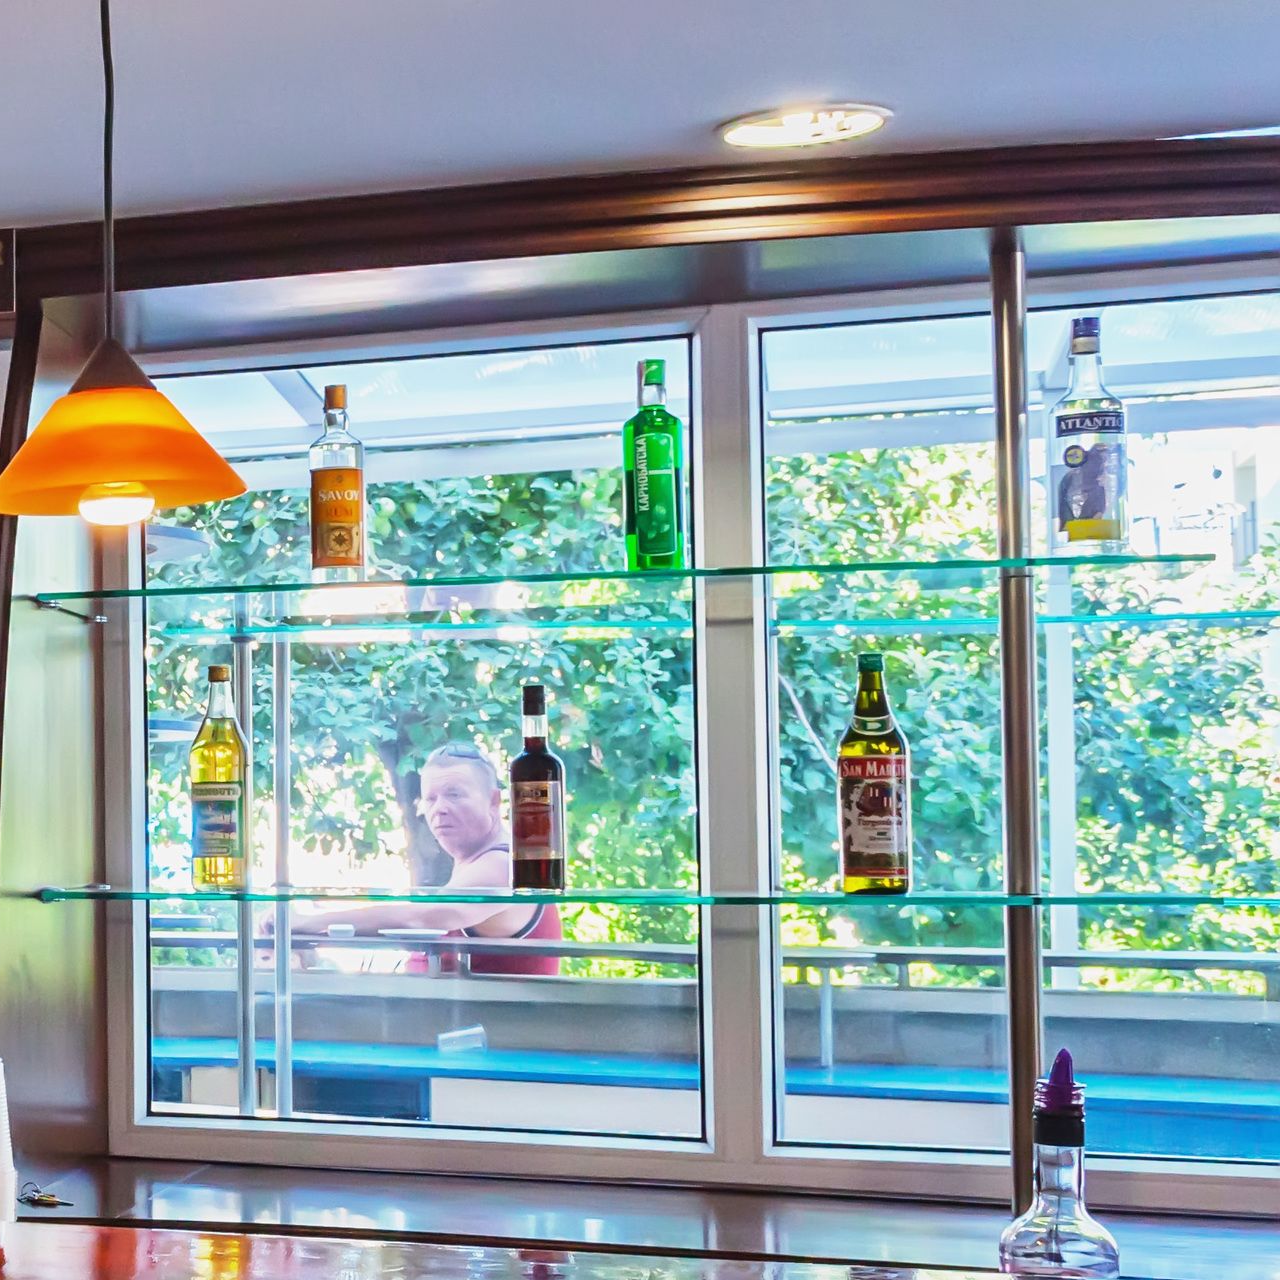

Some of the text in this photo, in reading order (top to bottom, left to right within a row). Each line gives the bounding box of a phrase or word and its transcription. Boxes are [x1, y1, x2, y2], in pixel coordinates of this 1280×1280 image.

[1060, 416, 1123, 430] ATLANTIC
[635, 437, 649, 511] КАРНОБАТСКА
[318, 489, 360, 502] SAVOY
